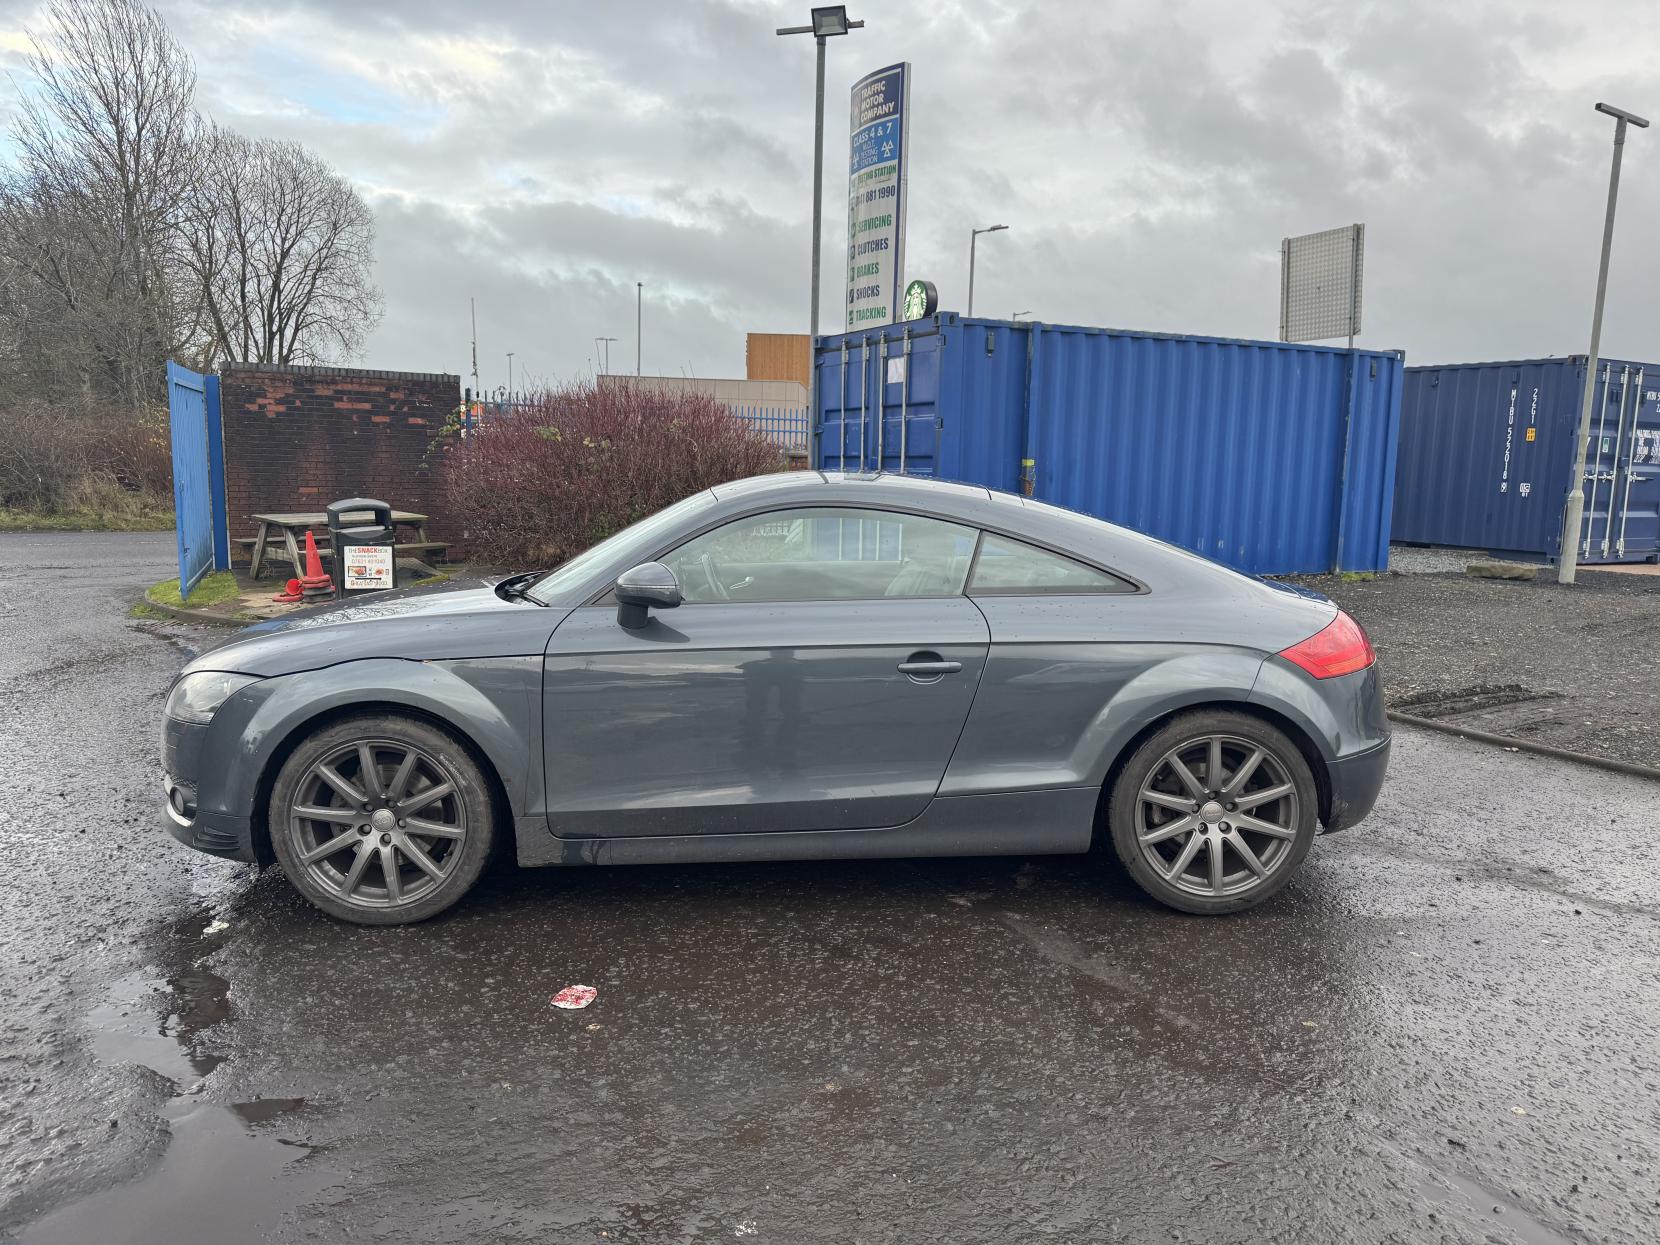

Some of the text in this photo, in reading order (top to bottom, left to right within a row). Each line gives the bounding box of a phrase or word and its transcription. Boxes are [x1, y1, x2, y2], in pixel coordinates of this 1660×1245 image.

[862, 81, 886, 98] TRAFFIC
[861, 94, 884, 110] MOTOR
[861, 102, 894, 122] COMPANY
[854, 122, 892, 147] CLASS 4 & 7
[874, 164, 896, 178] STATION
[866, 189, 876, 203] 881
[878, 184, 896, 200] 1990
[858, 214, 892, 233] SERVICING
[858, 238, 888, 256] CLUTCHES
[856, 262, 879, 278] BRAKES
[856, 285, 880, 300] SHOCKS
[856, 306, 886, 322] TRACKING
